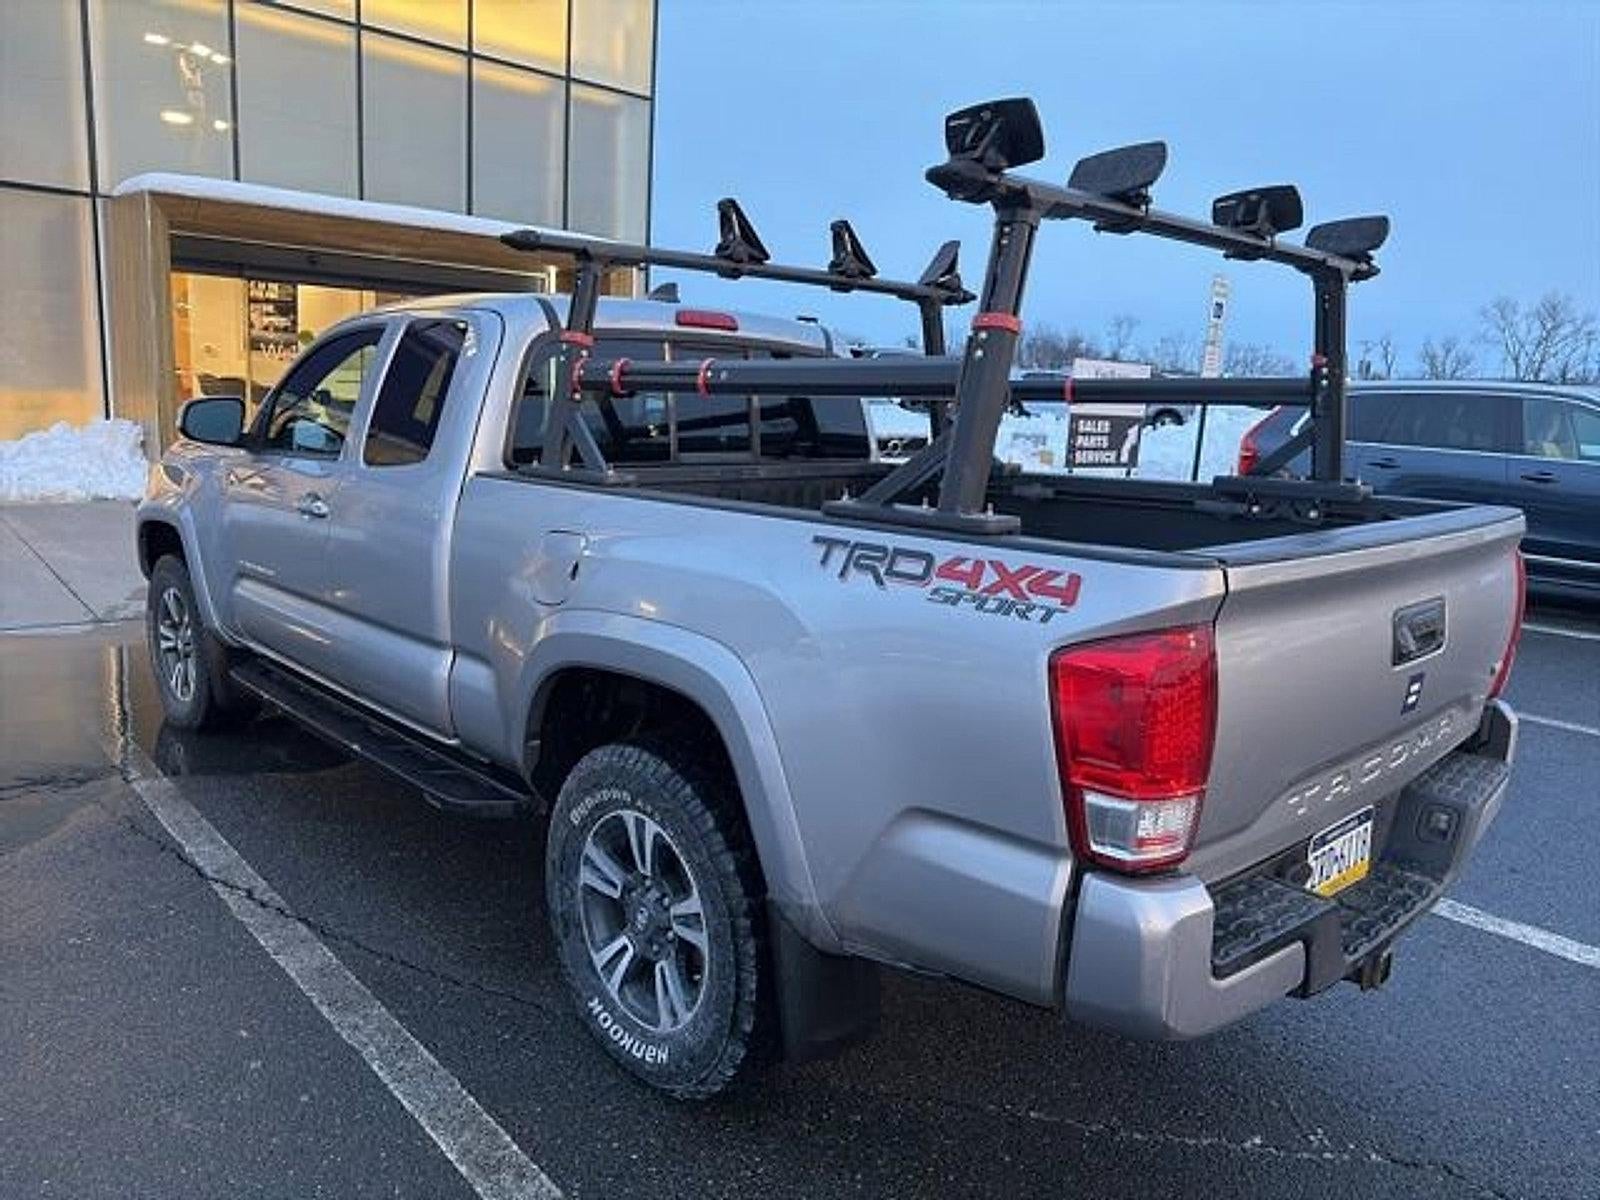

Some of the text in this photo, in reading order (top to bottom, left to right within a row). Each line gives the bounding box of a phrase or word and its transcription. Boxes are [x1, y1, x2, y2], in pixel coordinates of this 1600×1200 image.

[1077, 419, 1111, 433] SALES
[1075, 434, 1109, 448] PARTS
[1074, 449, 1118, 464] SERVICE
[811, 535, 936, 590] TRD
[926, 586, 1070, 624] SPORT
[1287, 715, 1452, 816] TACOMA
